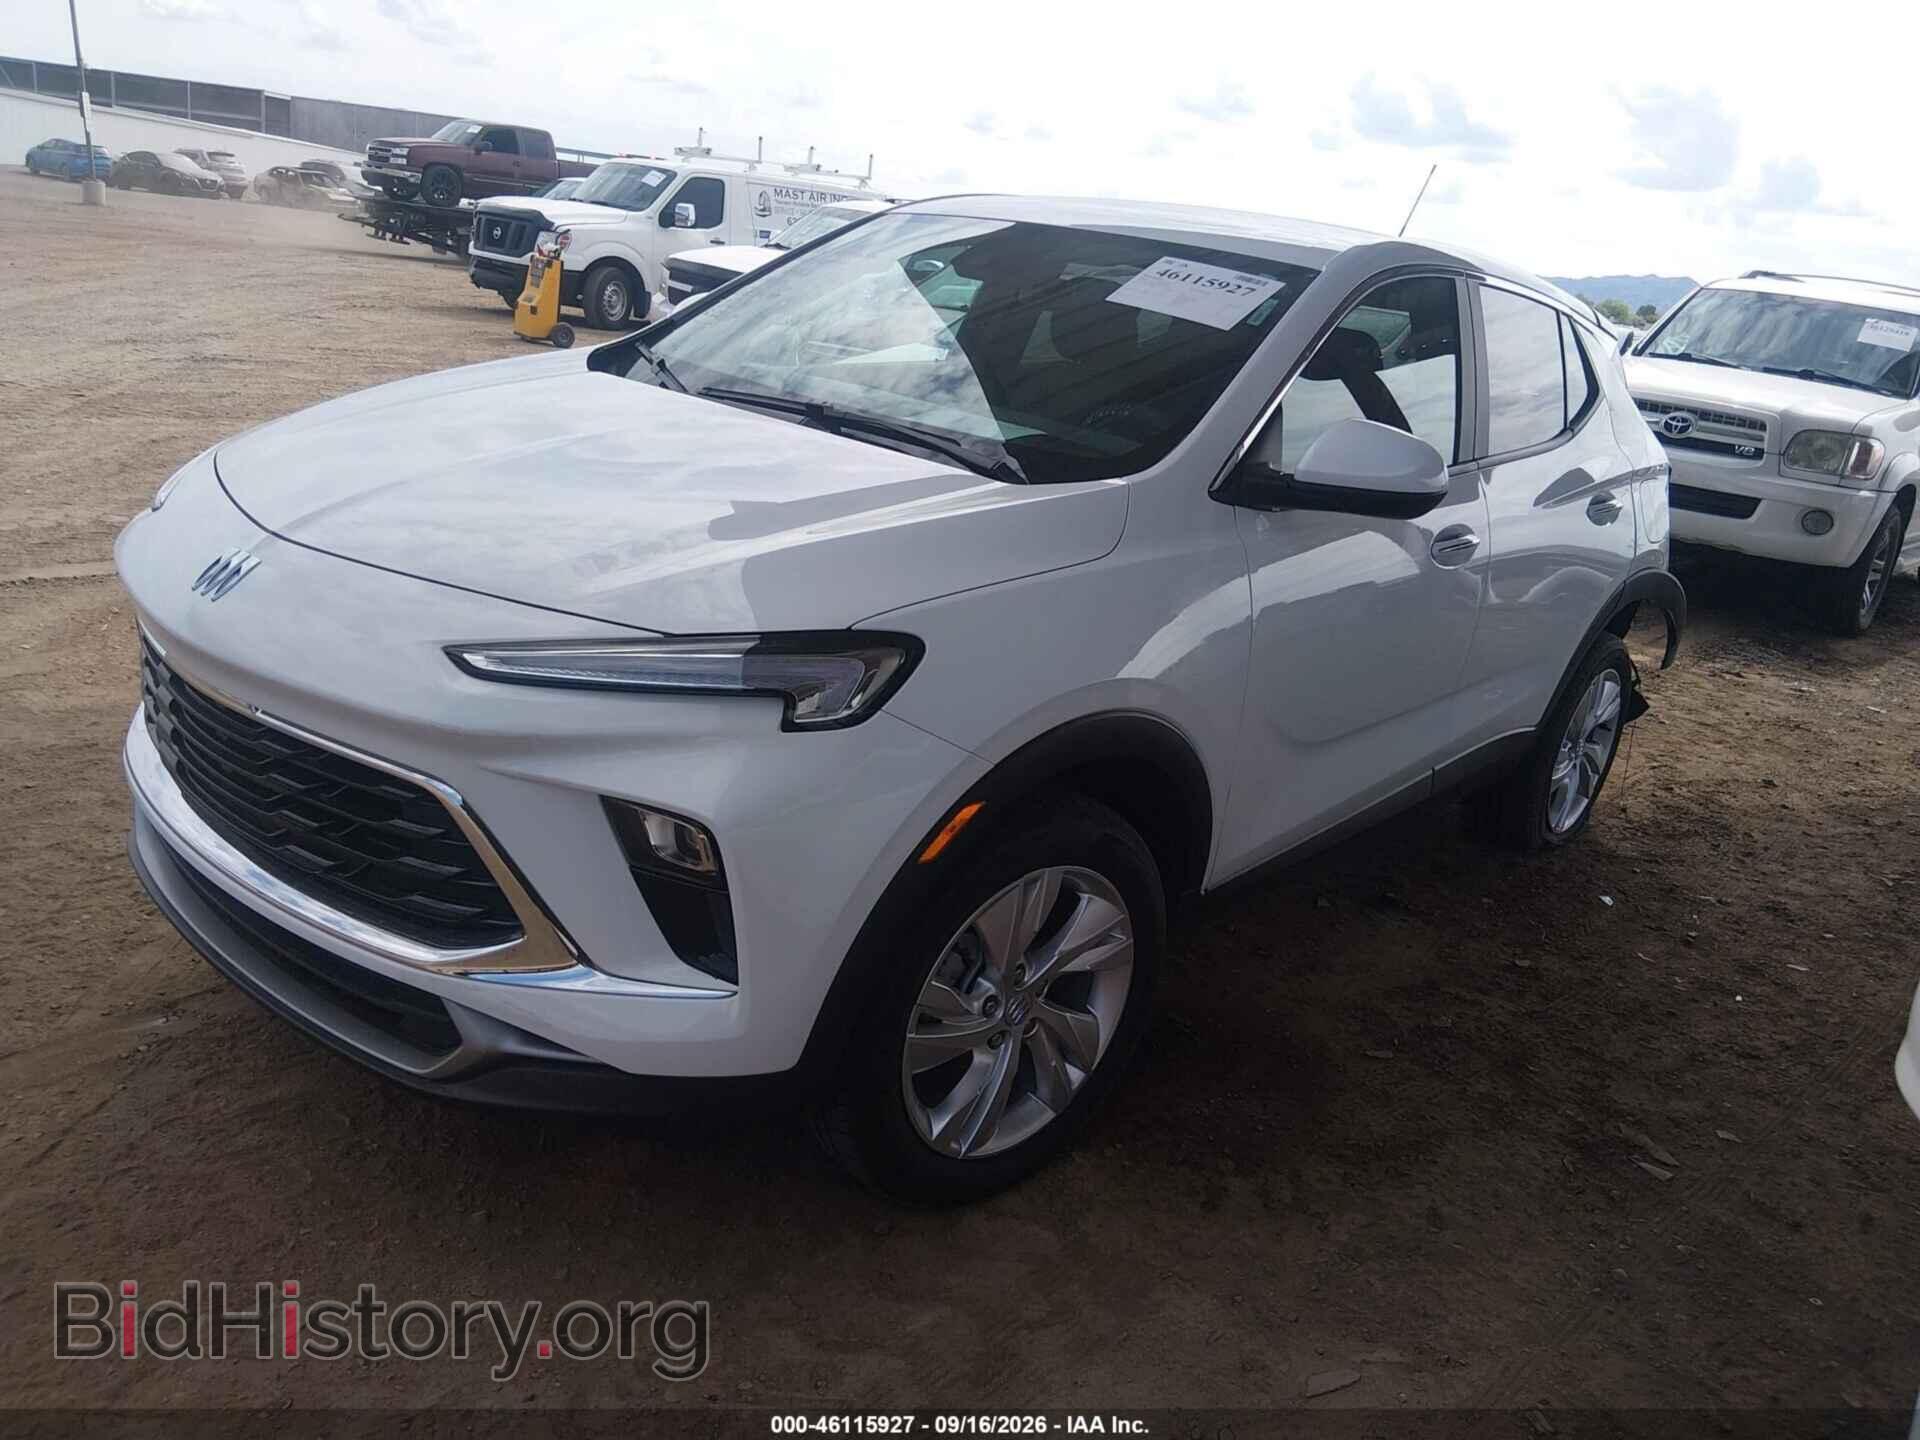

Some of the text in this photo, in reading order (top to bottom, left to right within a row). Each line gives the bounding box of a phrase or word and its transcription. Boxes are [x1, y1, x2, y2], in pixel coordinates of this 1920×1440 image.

[774, 188, 805, 200] MAST
[809, 191, 827, 202] AIR
[1156, 268, 1257, 296] 46115927
